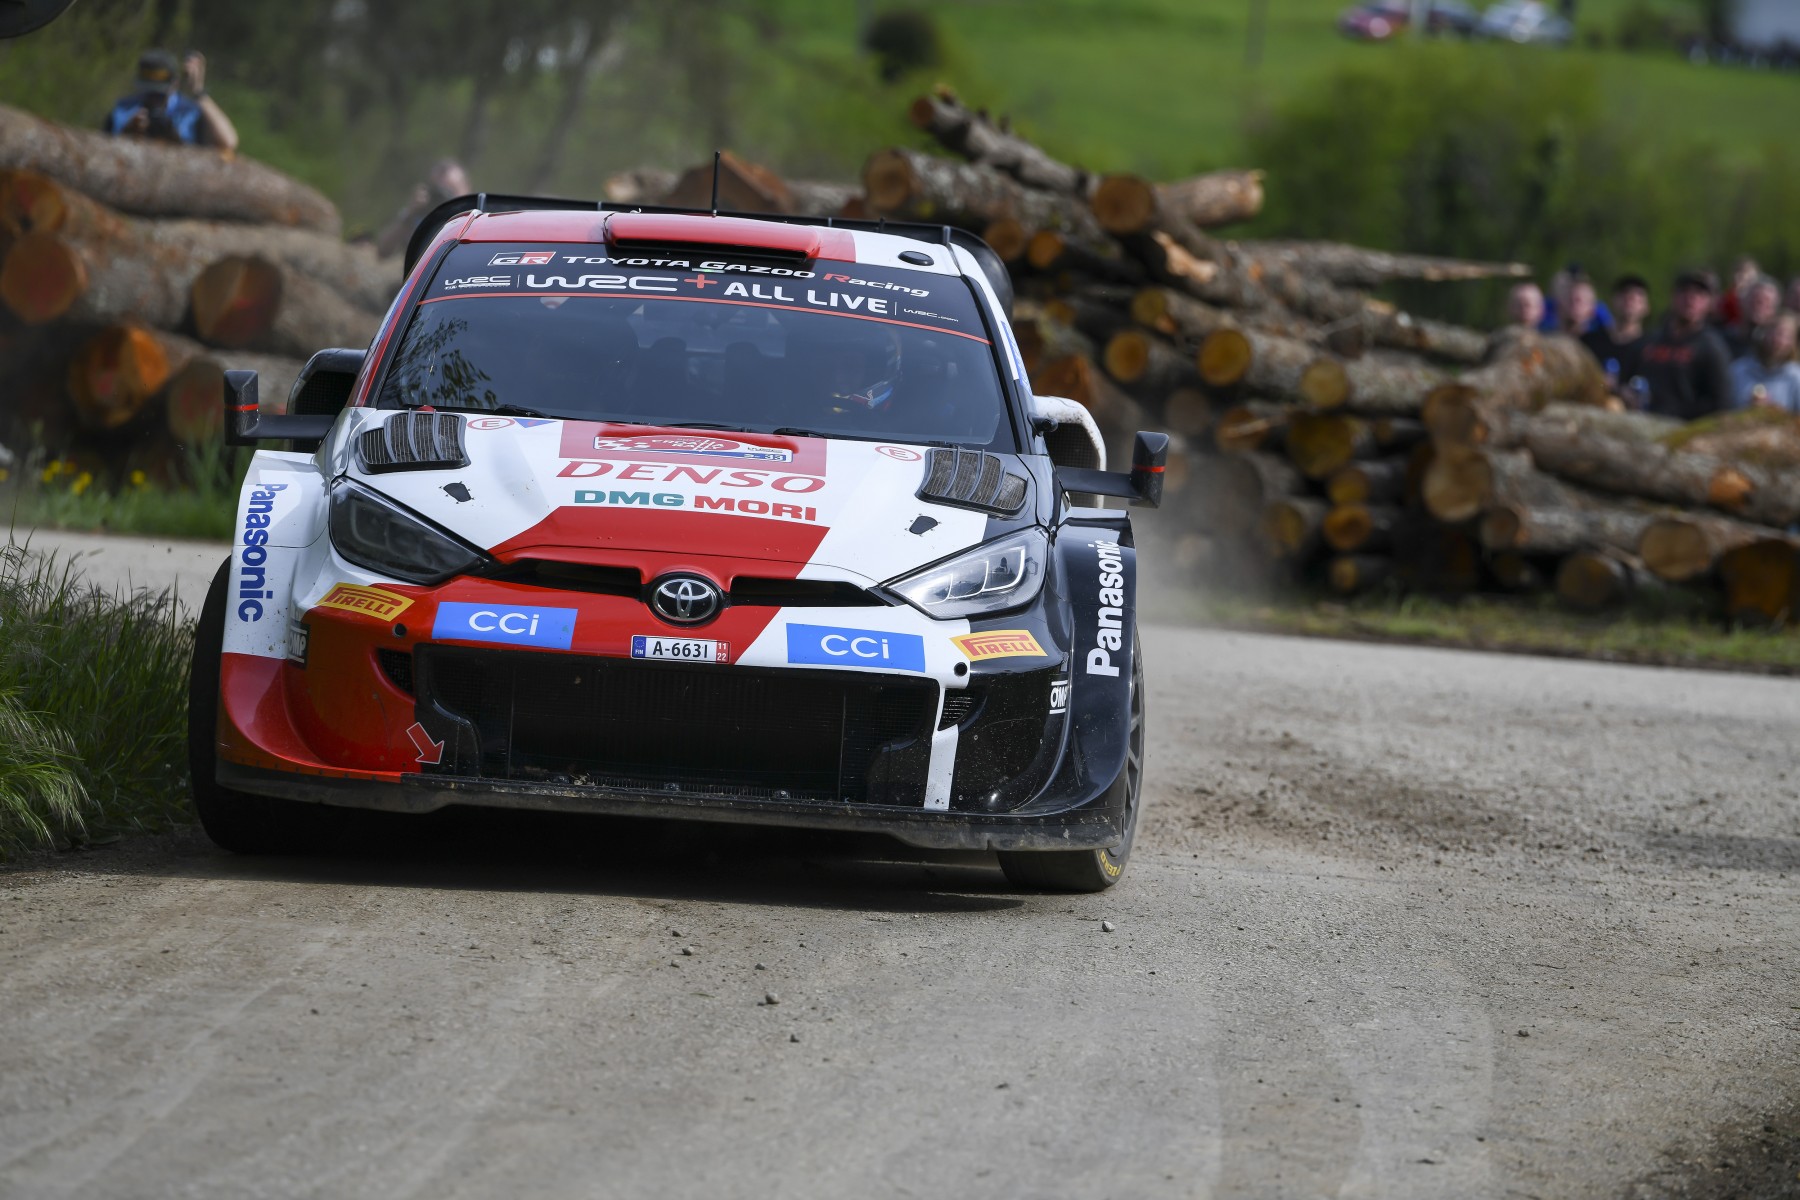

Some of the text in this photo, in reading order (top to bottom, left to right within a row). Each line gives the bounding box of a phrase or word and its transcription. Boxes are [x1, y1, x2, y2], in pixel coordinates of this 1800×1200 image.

[491, 256, 930, 298] GR TOYOTA GAZOO Racing
[444, 275, 512, 286] WRC
[723, 281, 795, 302] ALL
[807, 289, 888, 315] LIVE
[555, 460, 826, 494] DENSO
[574, 489, 817, 522] DMG MORI
[238, 483, 288, 623] Panasonic
[326, 586, 404, 616] PIRELLI
[1086, 540, 1124, 678] Panasonic
[652, 640, 708, 659] A-6631
[717, 652, 727, 661] 22
[960, 633, 1038, 657] PIRELLI
